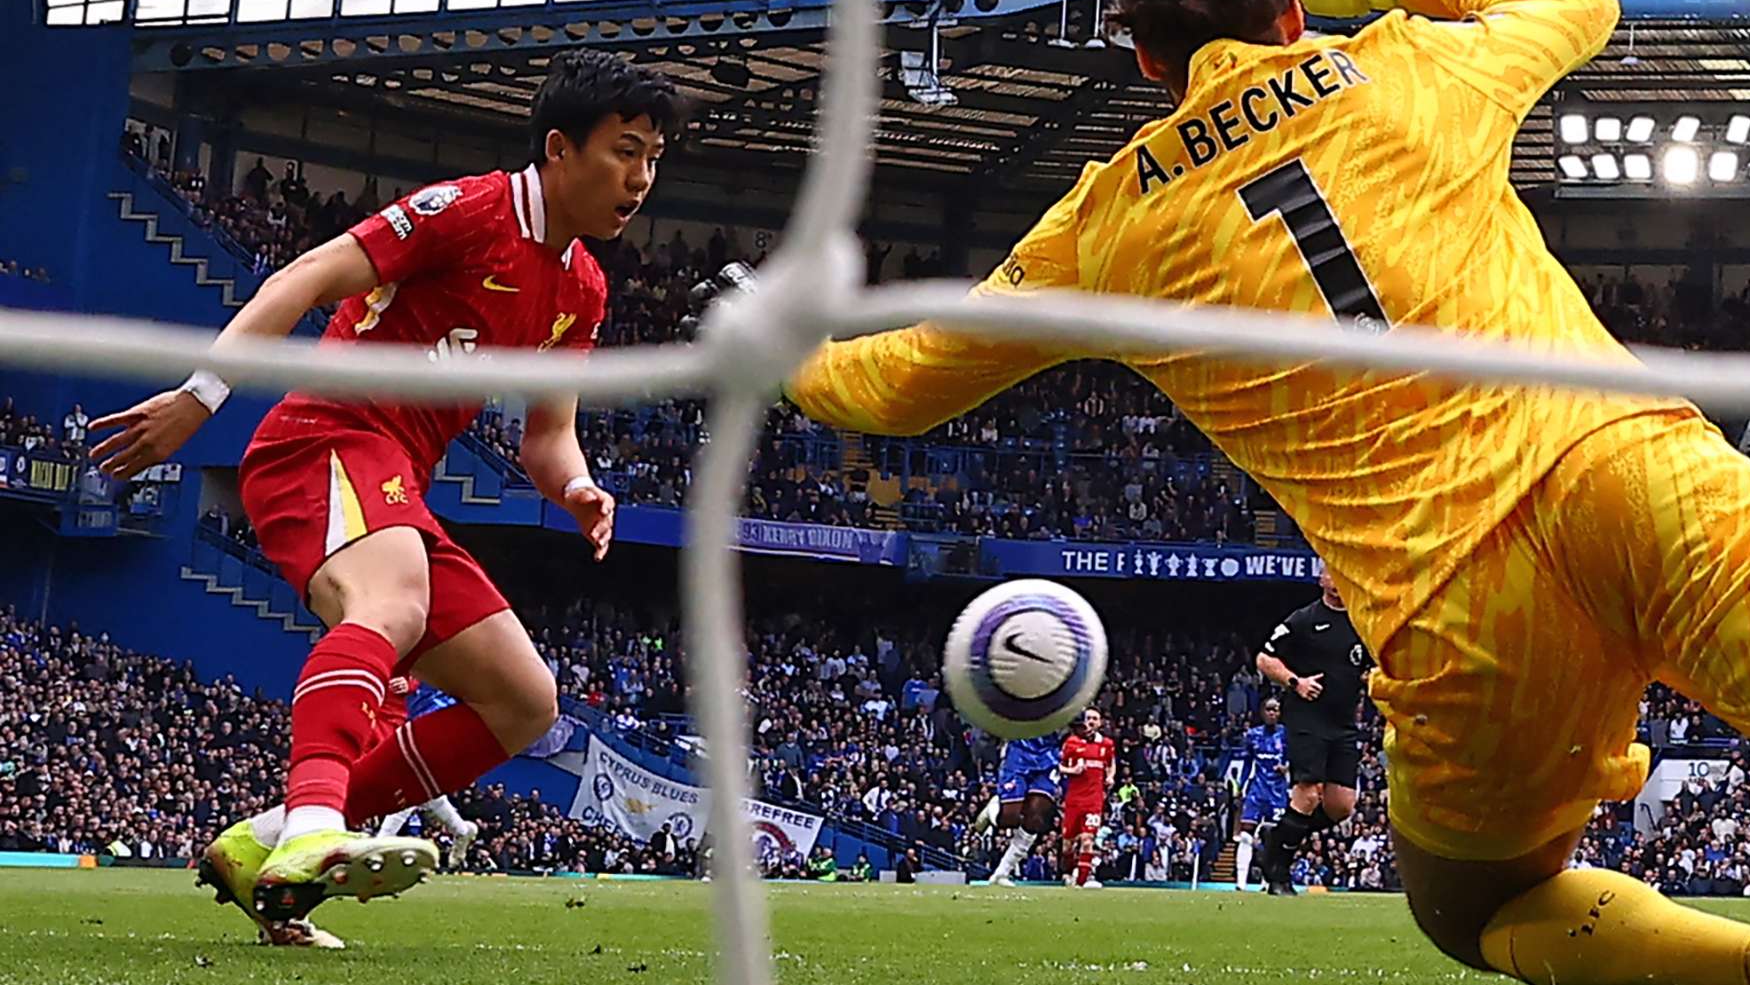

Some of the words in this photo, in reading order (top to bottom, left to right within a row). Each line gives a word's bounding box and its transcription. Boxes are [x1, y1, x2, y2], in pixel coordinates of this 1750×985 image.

[1237, 157, 1393, 336] 1
[1062, 551, 1109, 571] THE
[1245, 555, 1306, 577] WE'VE
[600, 751, 650, 789] CYPRUS
[651, 782, 699, 804] BLUES
[1688, 761, 1710, 777] 10
[1085, 813, 1101, 826] 20
